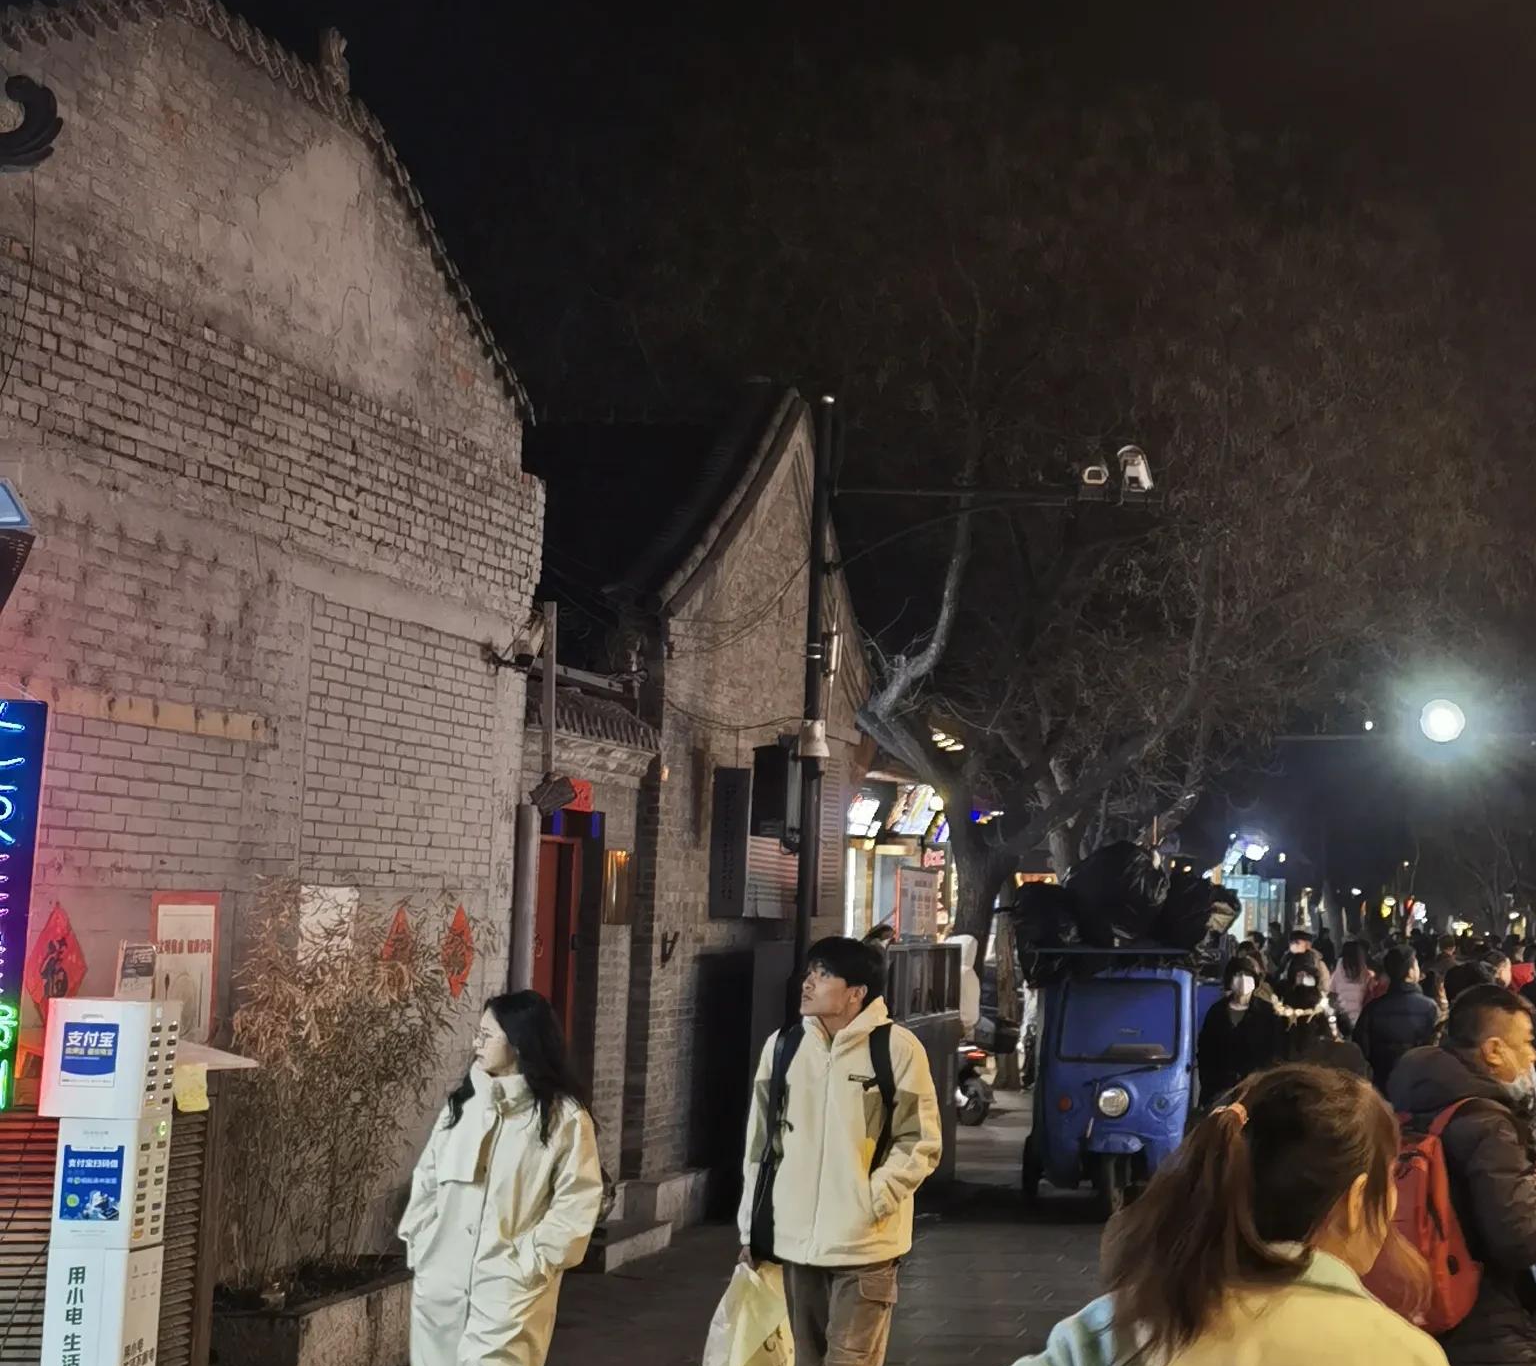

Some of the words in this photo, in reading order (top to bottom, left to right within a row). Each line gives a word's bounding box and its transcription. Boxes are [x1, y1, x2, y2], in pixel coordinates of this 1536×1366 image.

[66, 1031, 116, 1047] 支付宝
[65, 1266, 87, 1326] 用小电
